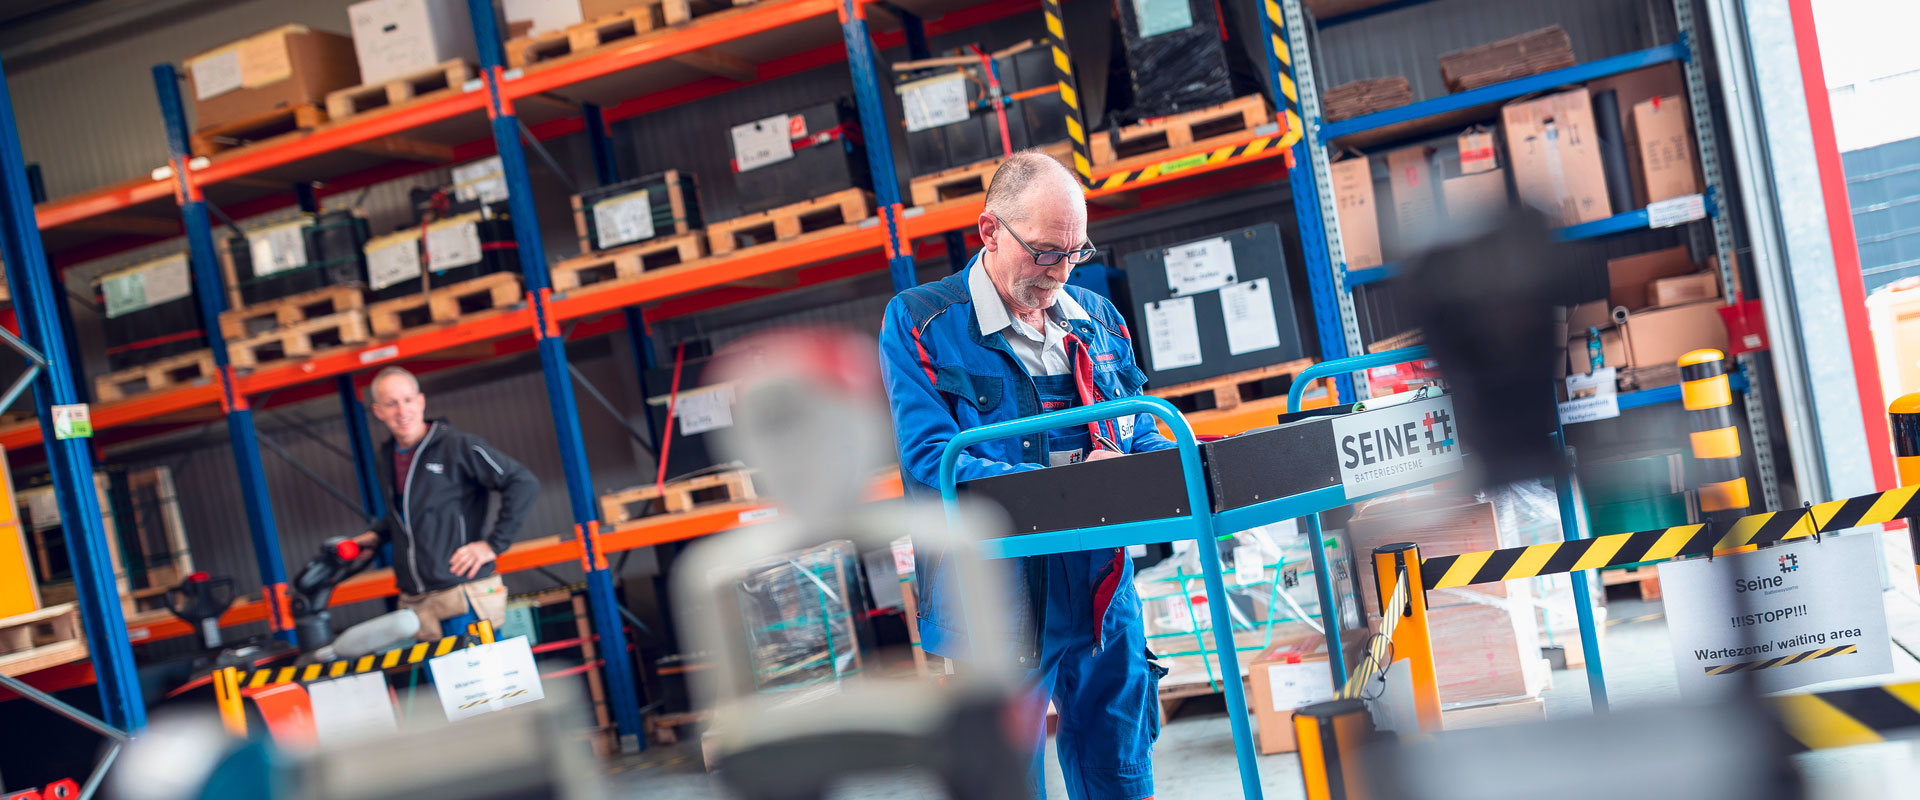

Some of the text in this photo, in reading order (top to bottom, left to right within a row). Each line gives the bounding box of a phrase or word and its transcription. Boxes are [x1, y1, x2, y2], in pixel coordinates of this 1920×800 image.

[1341, 421, 1420, 470] SEINE
[1354, 459, 1424, 483] BATTERIESYSTEME
[1735, 575, 1783, 593] Seine
[1731, 604, 1808, 628] !!!STOPP!!!
[1694, 628, 1862, 661] Wartezone/ waiting area
